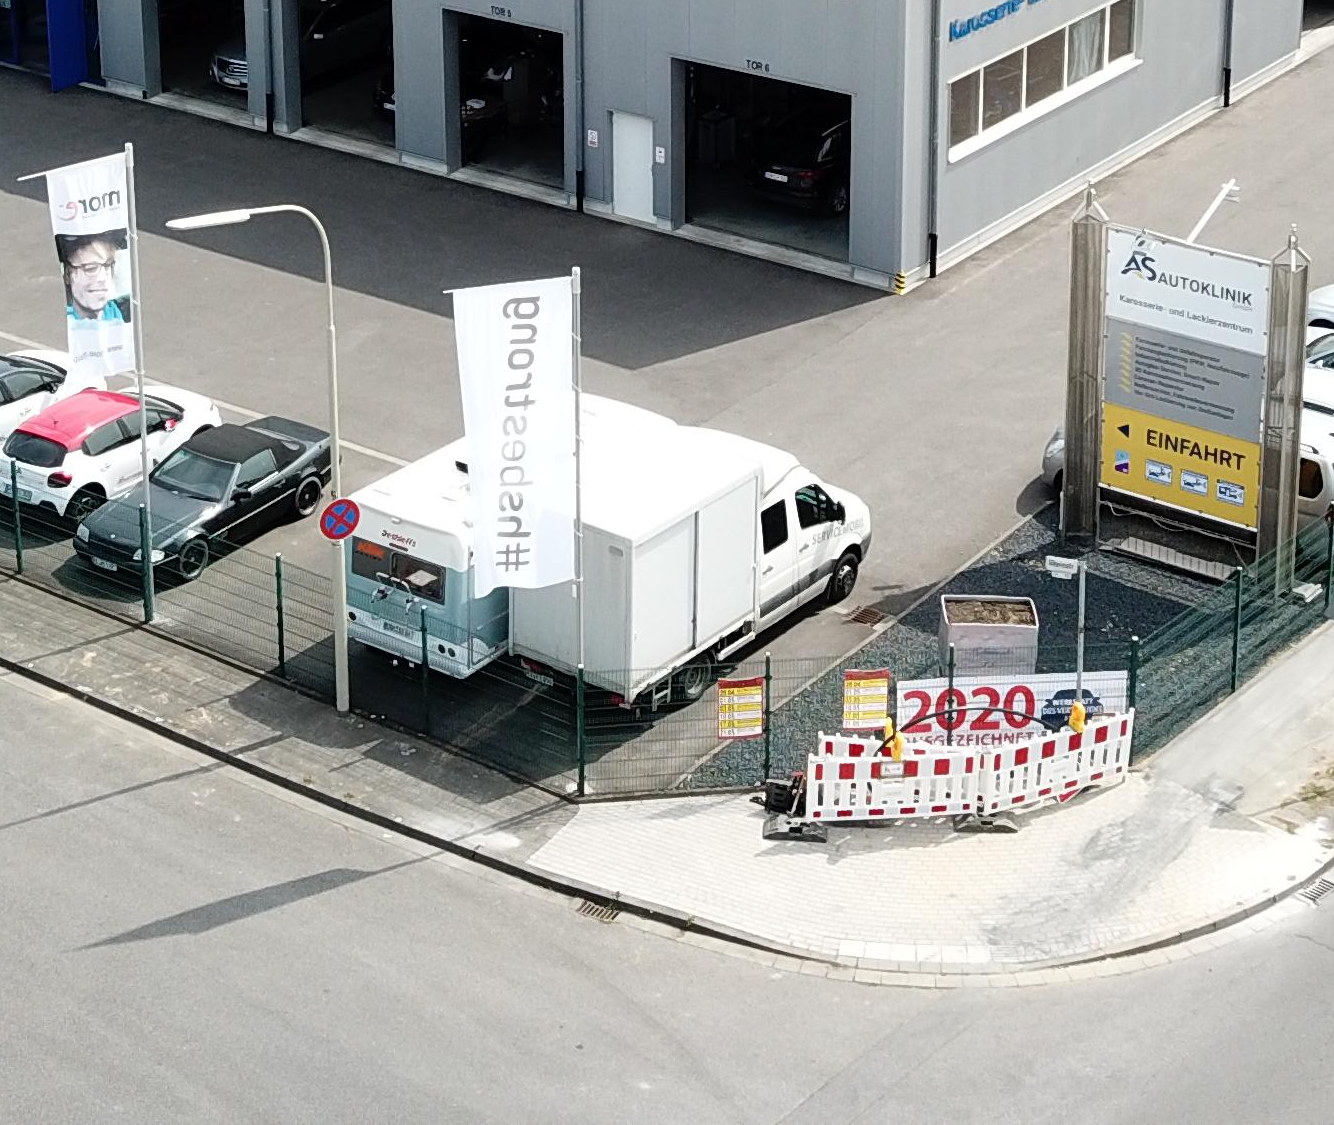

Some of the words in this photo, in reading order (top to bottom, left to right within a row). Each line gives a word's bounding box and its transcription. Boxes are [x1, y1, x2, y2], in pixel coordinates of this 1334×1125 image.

[490, 5, 506, 17] TOR
[746, 59, 763, 72] TOR
[1120, 253, 1157, 282] AS
[1157, 272, 1253, 306] AUTOKLINIK
[1119, 293, 1168, 312] Karosserie-
[1169, 306, 1185, 318] und
[1186, 310, 1253, 335] Lackierzentrum
[1146, 428, 1246, 470] EINFAHRT
[903, 684, 1036, 734] 2020
[904, 731, 1036, 747] SGZEICHNET
